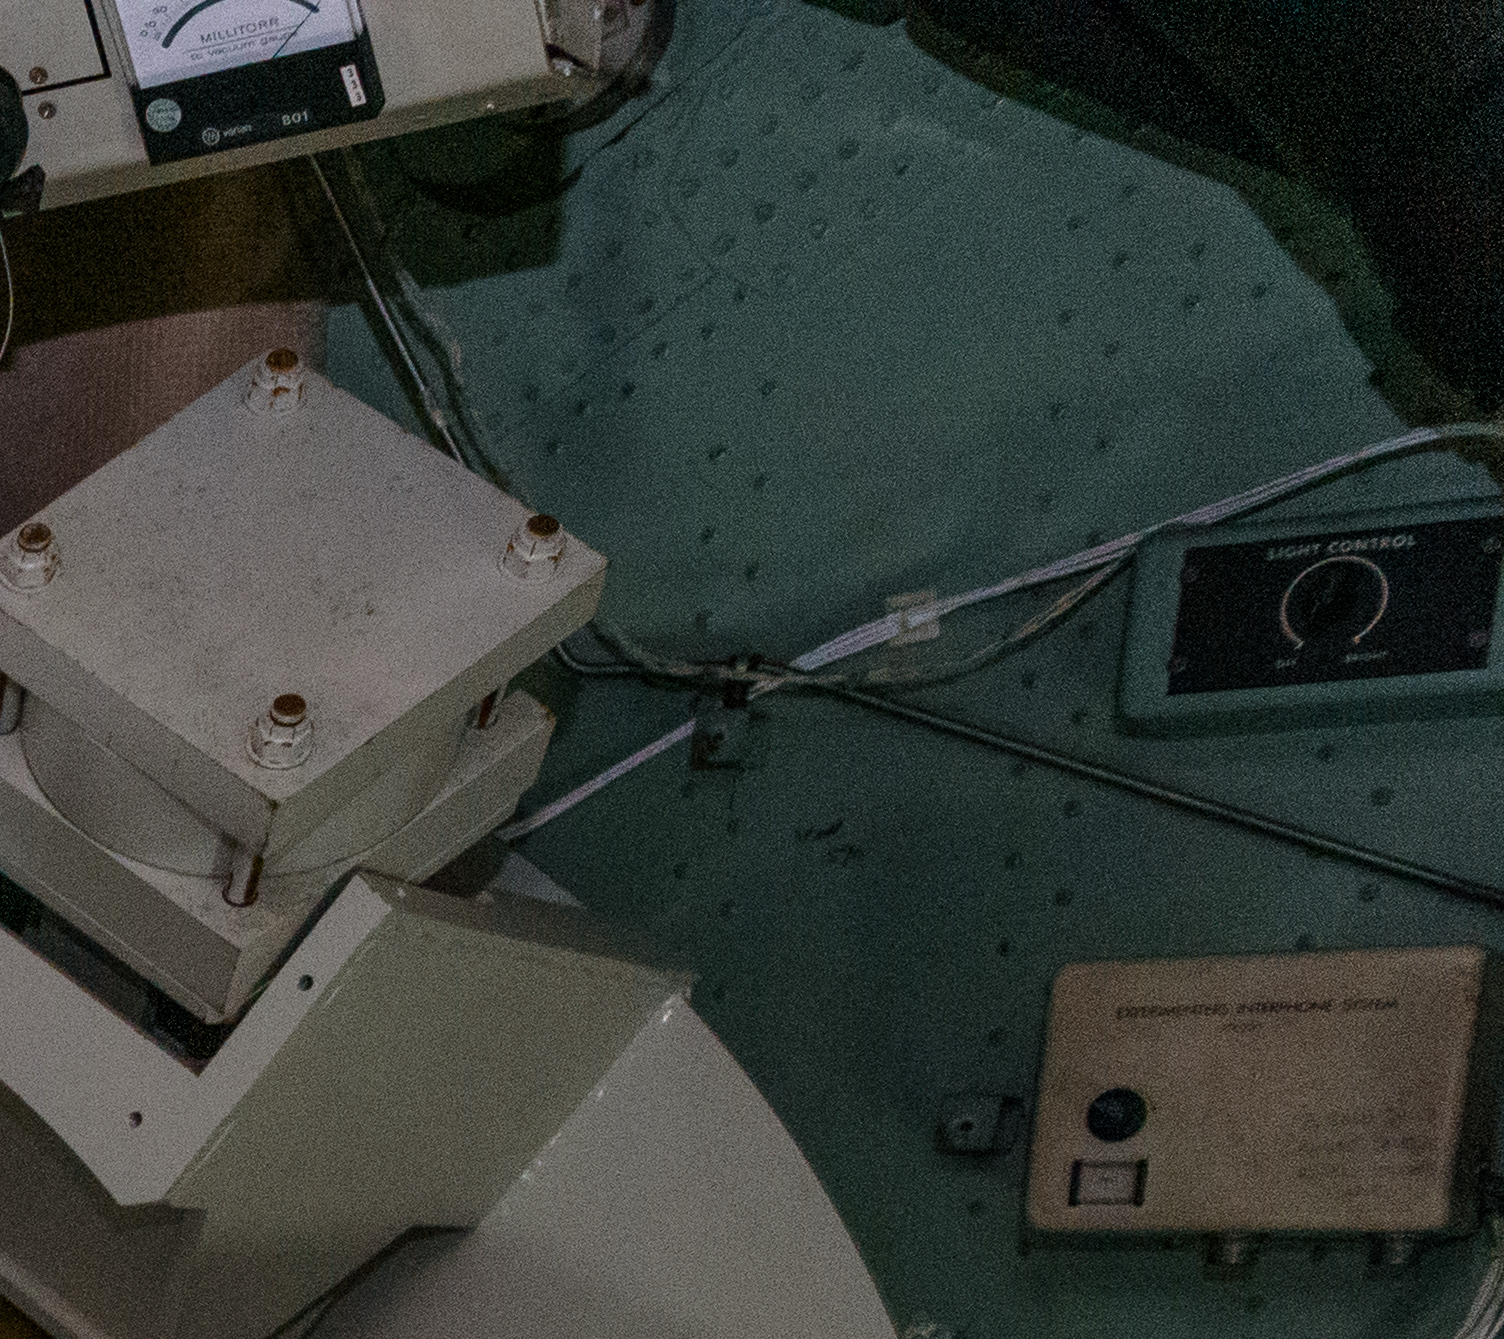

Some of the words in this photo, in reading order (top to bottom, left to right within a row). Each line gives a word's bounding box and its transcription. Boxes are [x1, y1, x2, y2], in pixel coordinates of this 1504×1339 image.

[200, 16, 281, 44] MILLITORR
[1267, 542, 1322, 562] LIGHT
[1327, 533, 1419, 555] CONTROL
[1341, 997, 1399, 1013] SYSTEM
